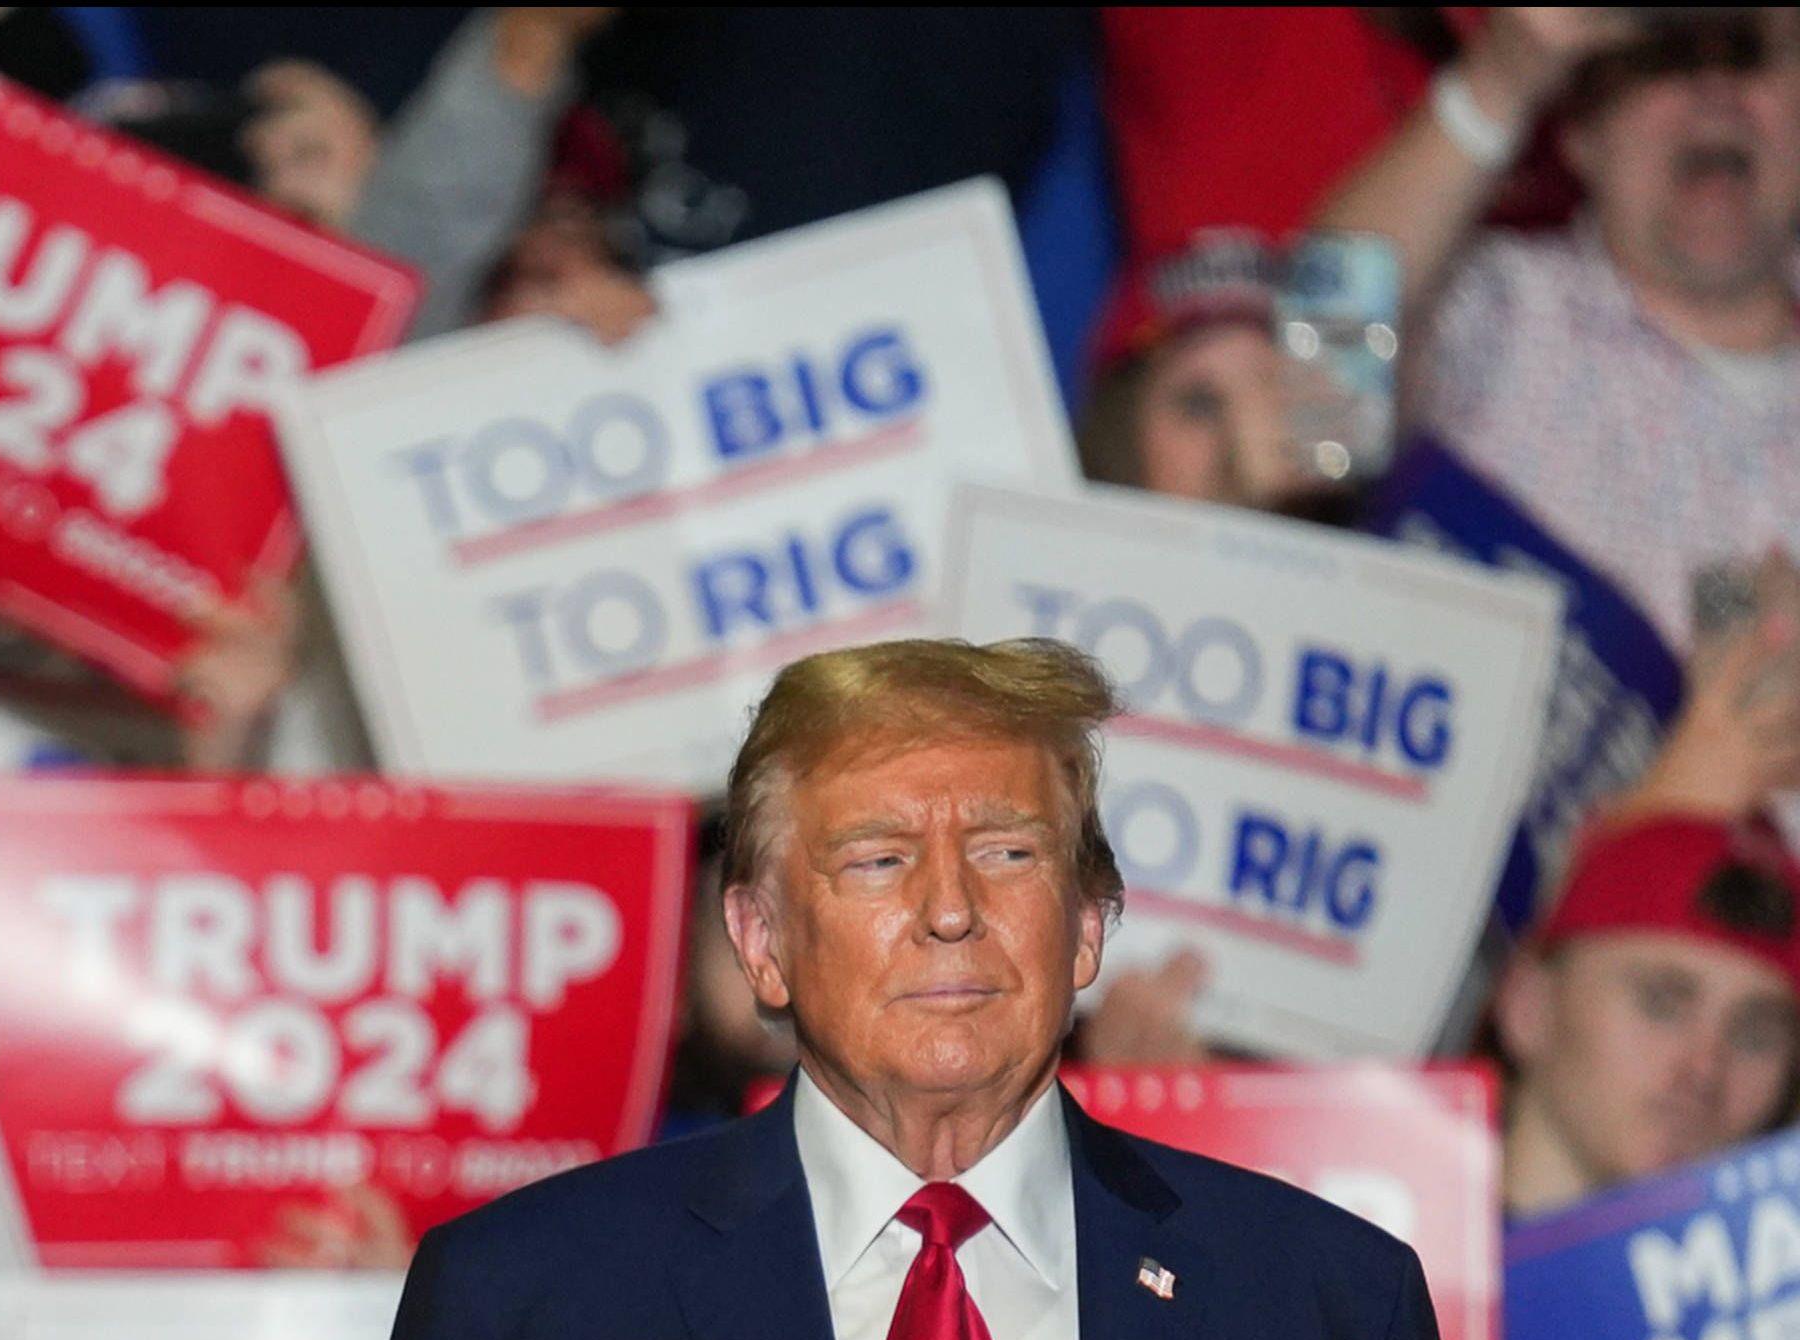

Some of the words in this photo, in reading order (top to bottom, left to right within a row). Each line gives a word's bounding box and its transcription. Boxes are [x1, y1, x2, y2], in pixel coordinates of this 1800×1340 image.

[390, 388, 678, 542] TOO
[697, 324, 929, 466] BIG
[492, 566, 672, 685] TO
[686, 503, 920, 640] RIG
[1290, 636, 1460, 774] BIG
[1096, 778, 1202, 887] O
[1227, 801, 1386, 936] RIG
[32, 871, 626, 1014] TRUMP
[115, 1000, 540, 1135] 2024
